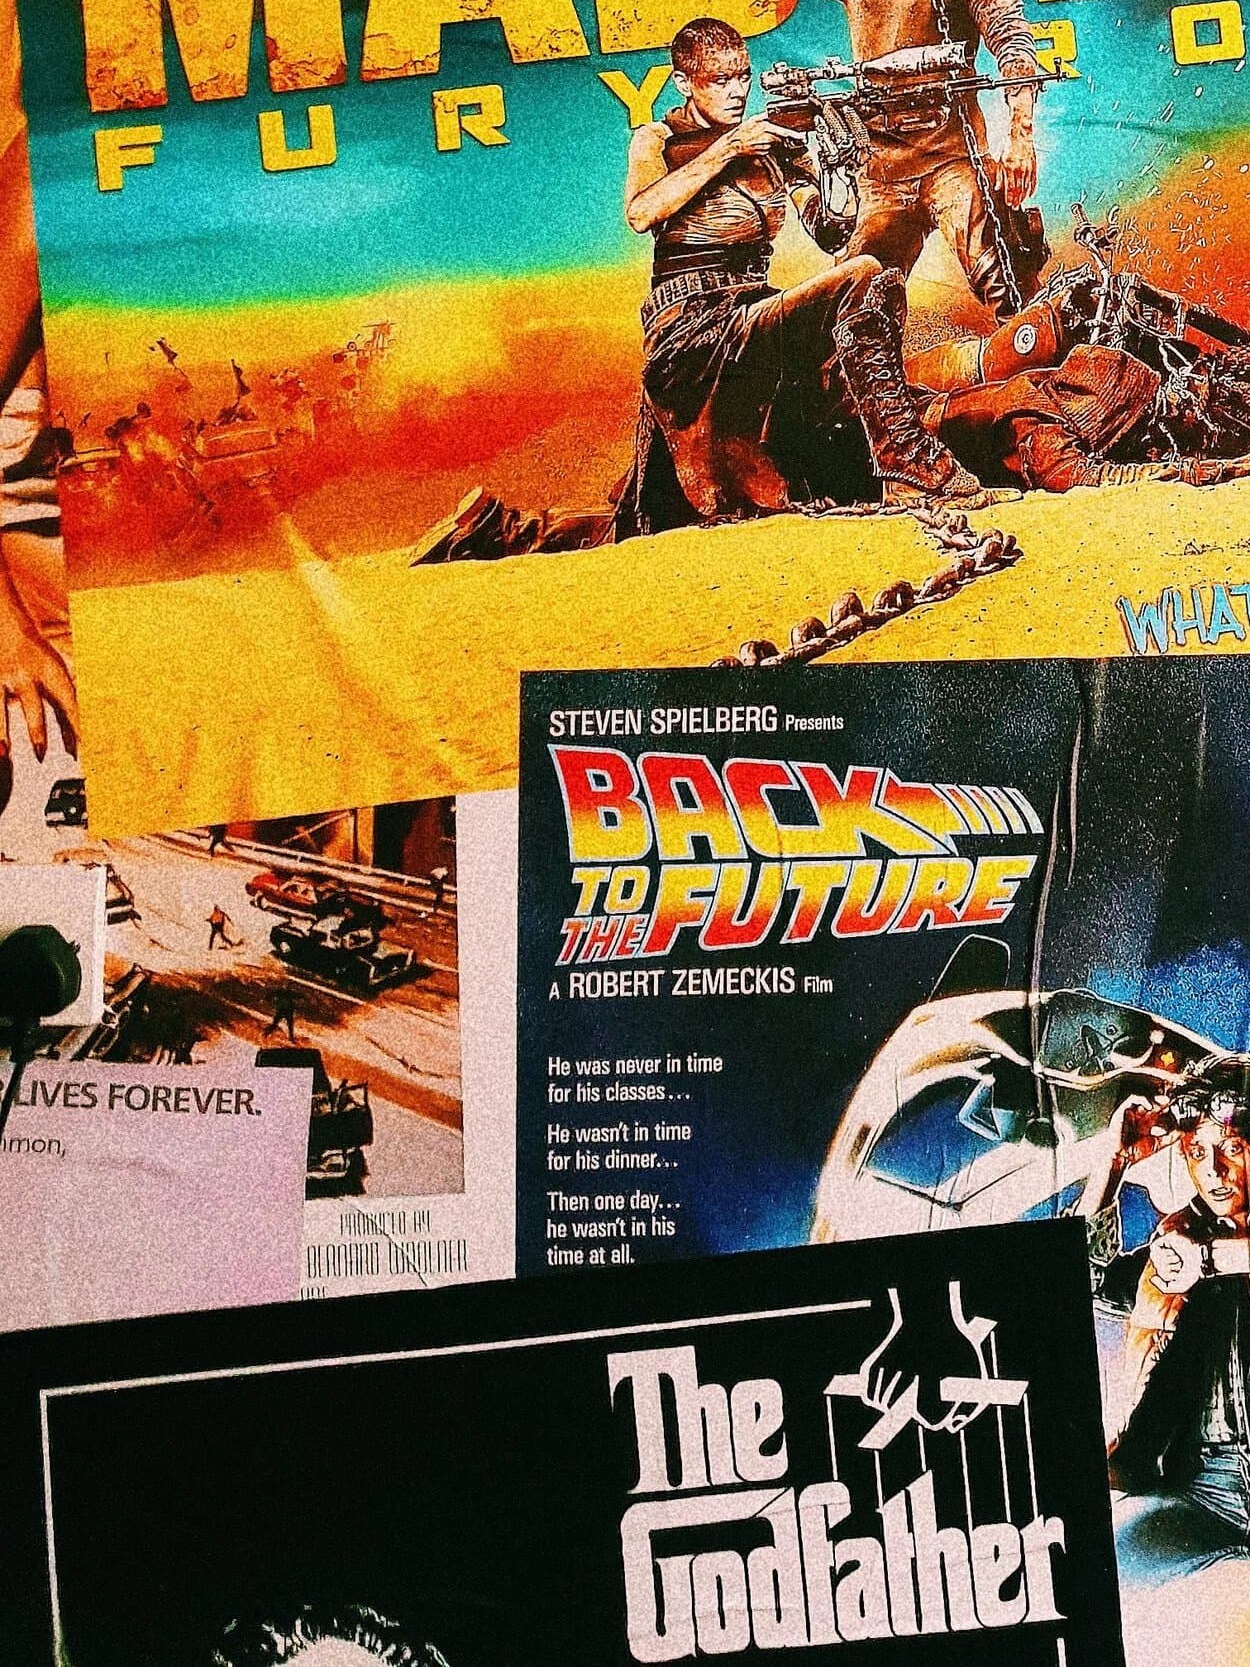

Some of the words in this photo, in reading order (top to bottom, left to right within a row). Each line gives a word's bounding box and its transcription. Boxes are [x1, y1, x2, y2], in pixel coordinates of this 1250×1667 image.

[94, 63, 676, 192] FURY
[549, 709, 641, 737] STEVEN
[650, 705, 777, 735] SPIELBERG
[785, 713, 844, 732] Presents
[547, 742, 1044, 863] BACK
[570, 865, 653, 917] TO
[638, 853, 1038, 958] FUTURE
[555, 913, 649, 967] THE
[548, 983, 561, 1001] A
[569, 971, 665, 999] ROBERT
[671, 967, 797, 996] ZEMECKIS
[803, 976, 834, 995] Film
[547, 1056, 571, 1077] He
[575, 1060, 611, 1076] was
[615, 1058, 662, 1076] never
[666, 1053, 682, 1074] in
[686, 1052, 724, 1074] time
[109, 1082, 262, 1116] FOREVER.
[547, 1083, 571, 1104] for
[576, 1082, 601, 1103] his
[547, 1124, 570, 1144] He
[575, 1121, 630, 1143] wasn't
[634, 1121, 649, 1141] in
[654, 1122, 692, 1141] time
[547, 1150, 571, 1171] for
[575, 1150, 600, 1171] his
[546, 1191, 589, 1212] Then
[594, 1194, 625, 1211] one
[546, 1218, 568, 1239] he
[571, 1216, 626, 1238] wasn't
[630, 1216, 647, 1237] in
[651, 1215, 676, 1236] his
[547, 1245, 584, 1266] time
[588, 1246, 606, 1265] at
[610, 1243, 635, 1264] all.
[606, 1344, 789, 1495] The
[619, 1469, 1068, 1664] Godfather
